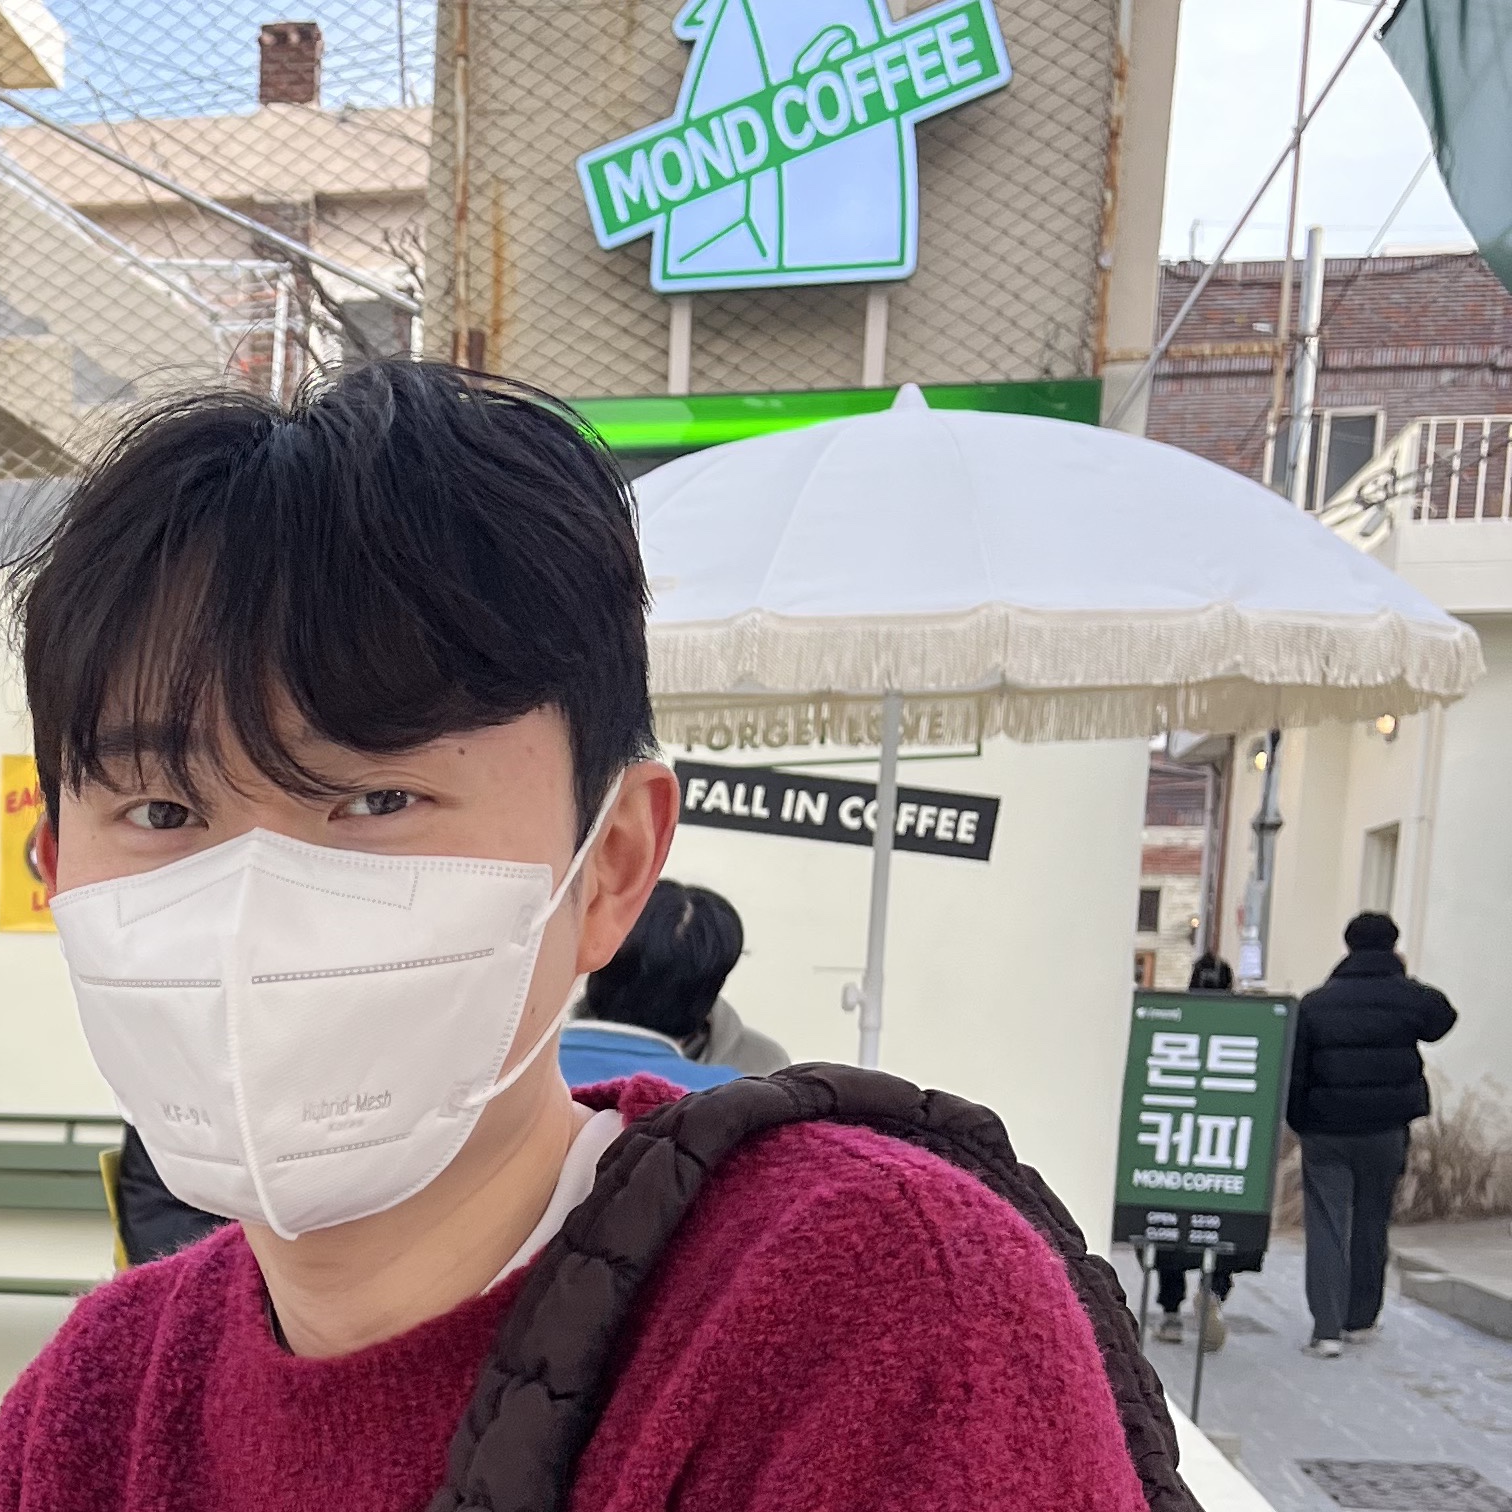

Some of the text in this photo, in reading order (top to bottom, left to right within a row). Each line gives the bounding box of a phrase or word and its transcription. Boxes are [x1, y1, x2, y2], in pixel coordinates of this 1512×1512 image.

[603, 12, 982, 223] MOND COFFEE
[685, 778, 770, 819] FALL
[780, 788, 829, 826] IN
[1146, 1031, 1259, 1093] 몬트
[302, 1090, 392, 1123] Hybrid-Mesh
[1137, 1111, 1253, 1170] 커피
[1133, 1168, 1246, 1195] MOND COFFEE
